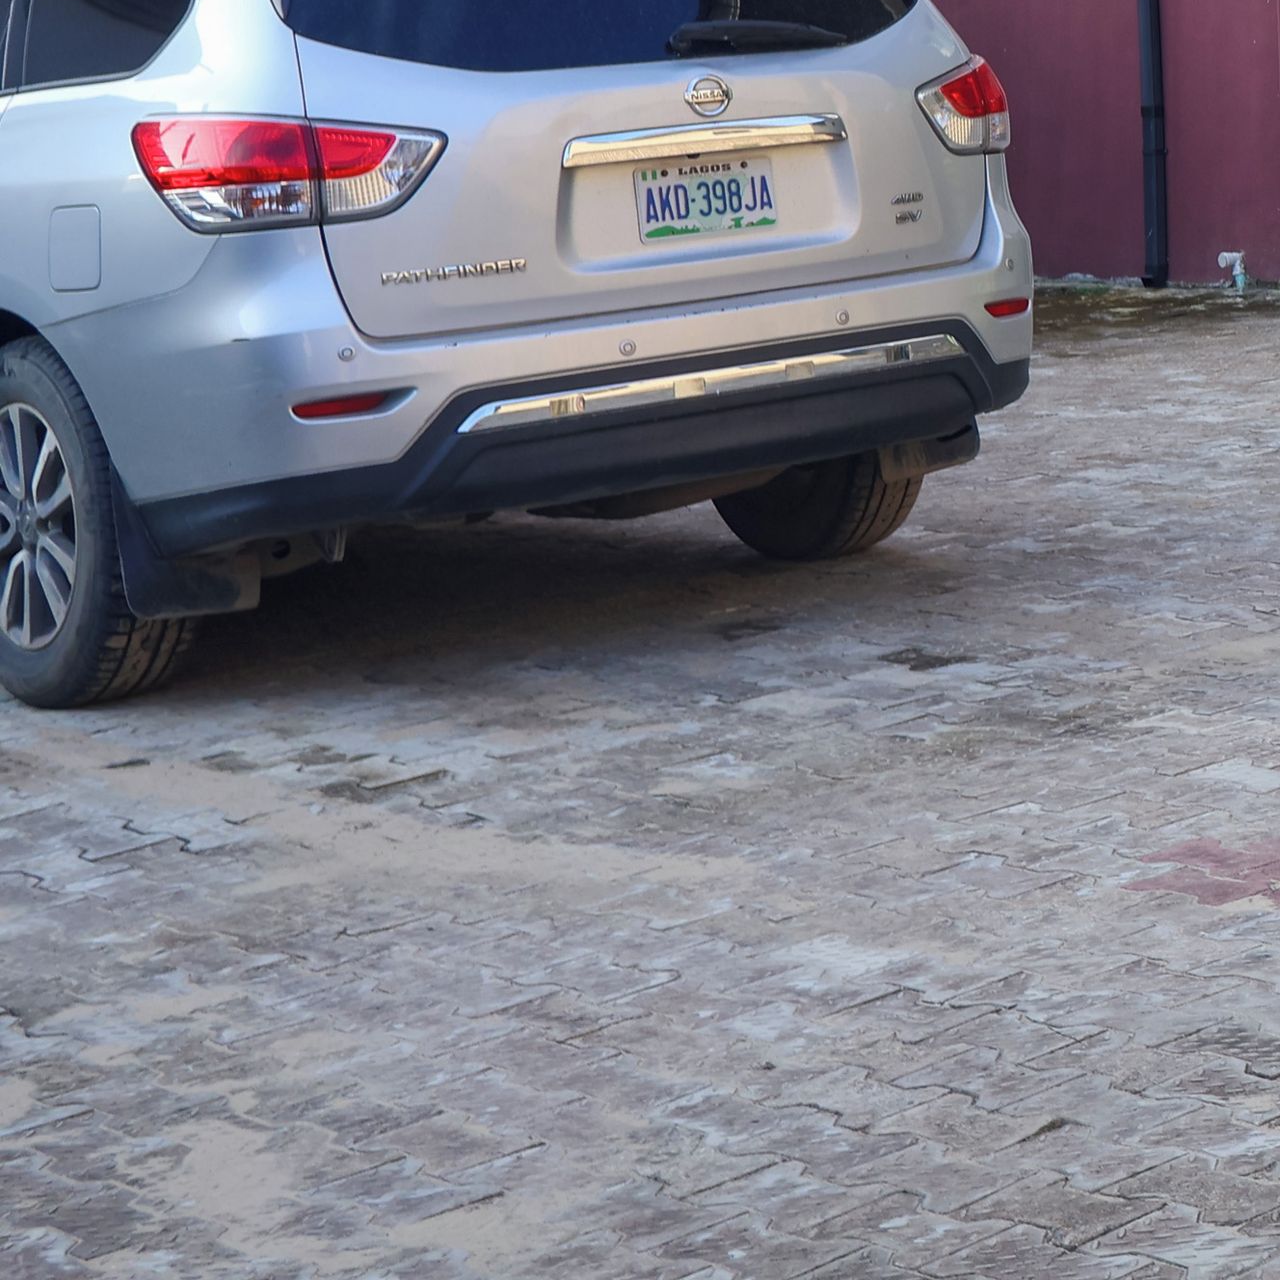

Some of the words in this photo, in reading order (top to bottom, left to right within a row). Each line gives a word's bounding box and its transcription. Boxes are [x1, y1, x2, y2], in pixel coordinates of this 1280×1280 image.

[678, 162, 732, 176] LAGOS
[645, 175, 773, 224] AKD-398JA
[381, 257, 527, 286] PATHFINDER
